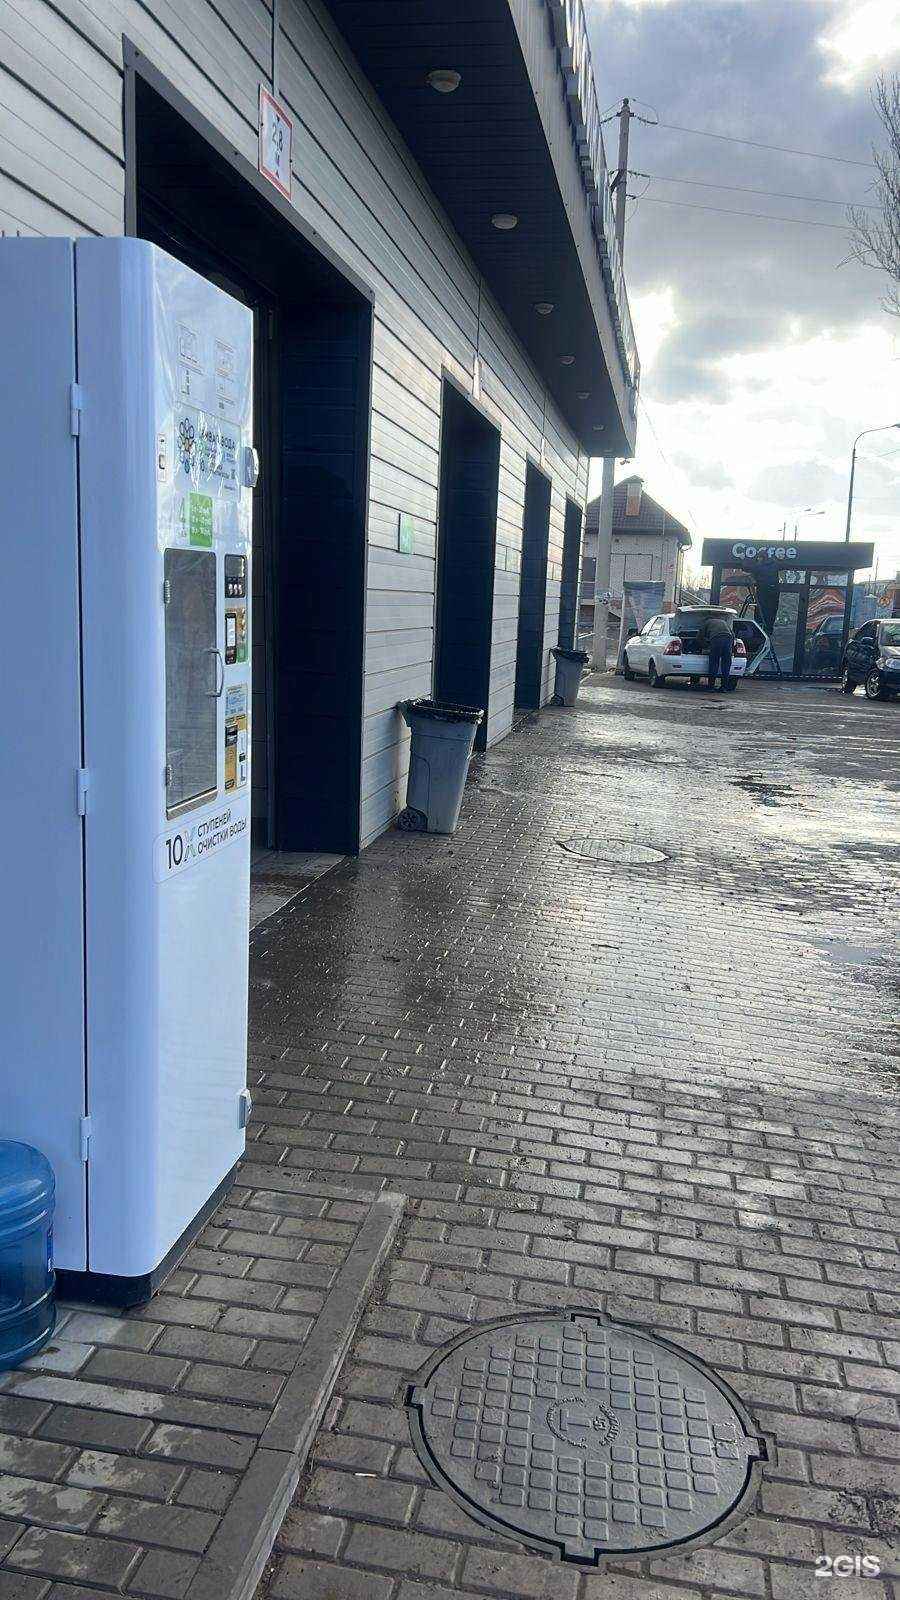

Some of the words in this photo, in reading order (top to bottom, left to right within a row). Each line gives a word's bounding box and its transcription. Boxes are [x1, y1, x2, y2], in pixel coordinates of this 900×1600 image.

[197, 808, 231, 837] СТУПЕНЕЙ
[197, 828, 229, 854] ОЧИСТКИ
[230, 817, 247, 837] ВОДЫ
